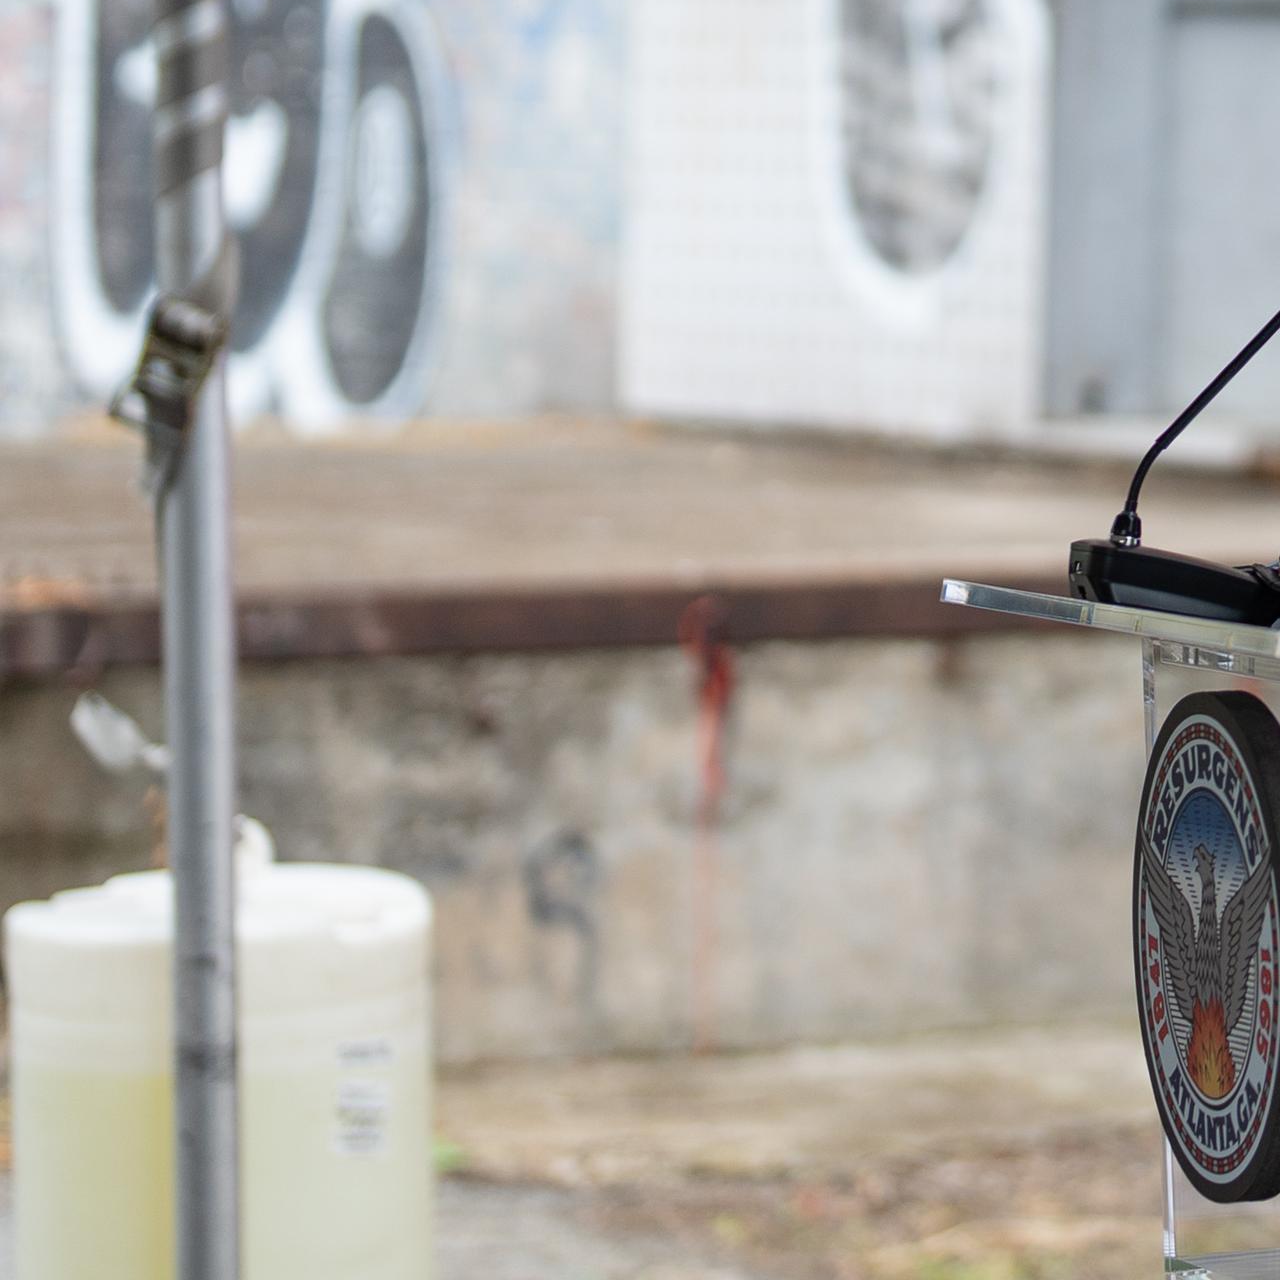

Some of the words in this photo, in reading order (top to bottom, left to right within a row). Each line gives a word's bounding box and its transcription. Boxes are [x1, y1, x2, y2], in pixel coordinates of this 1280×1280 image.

[1151, 743, 1260, 866] RESURGENS
[1148, 933, 1169, 1045] 1847
[1256, 948, 1272, 1063] 1865
[1236, 1079, 1262, 1132] GA.
